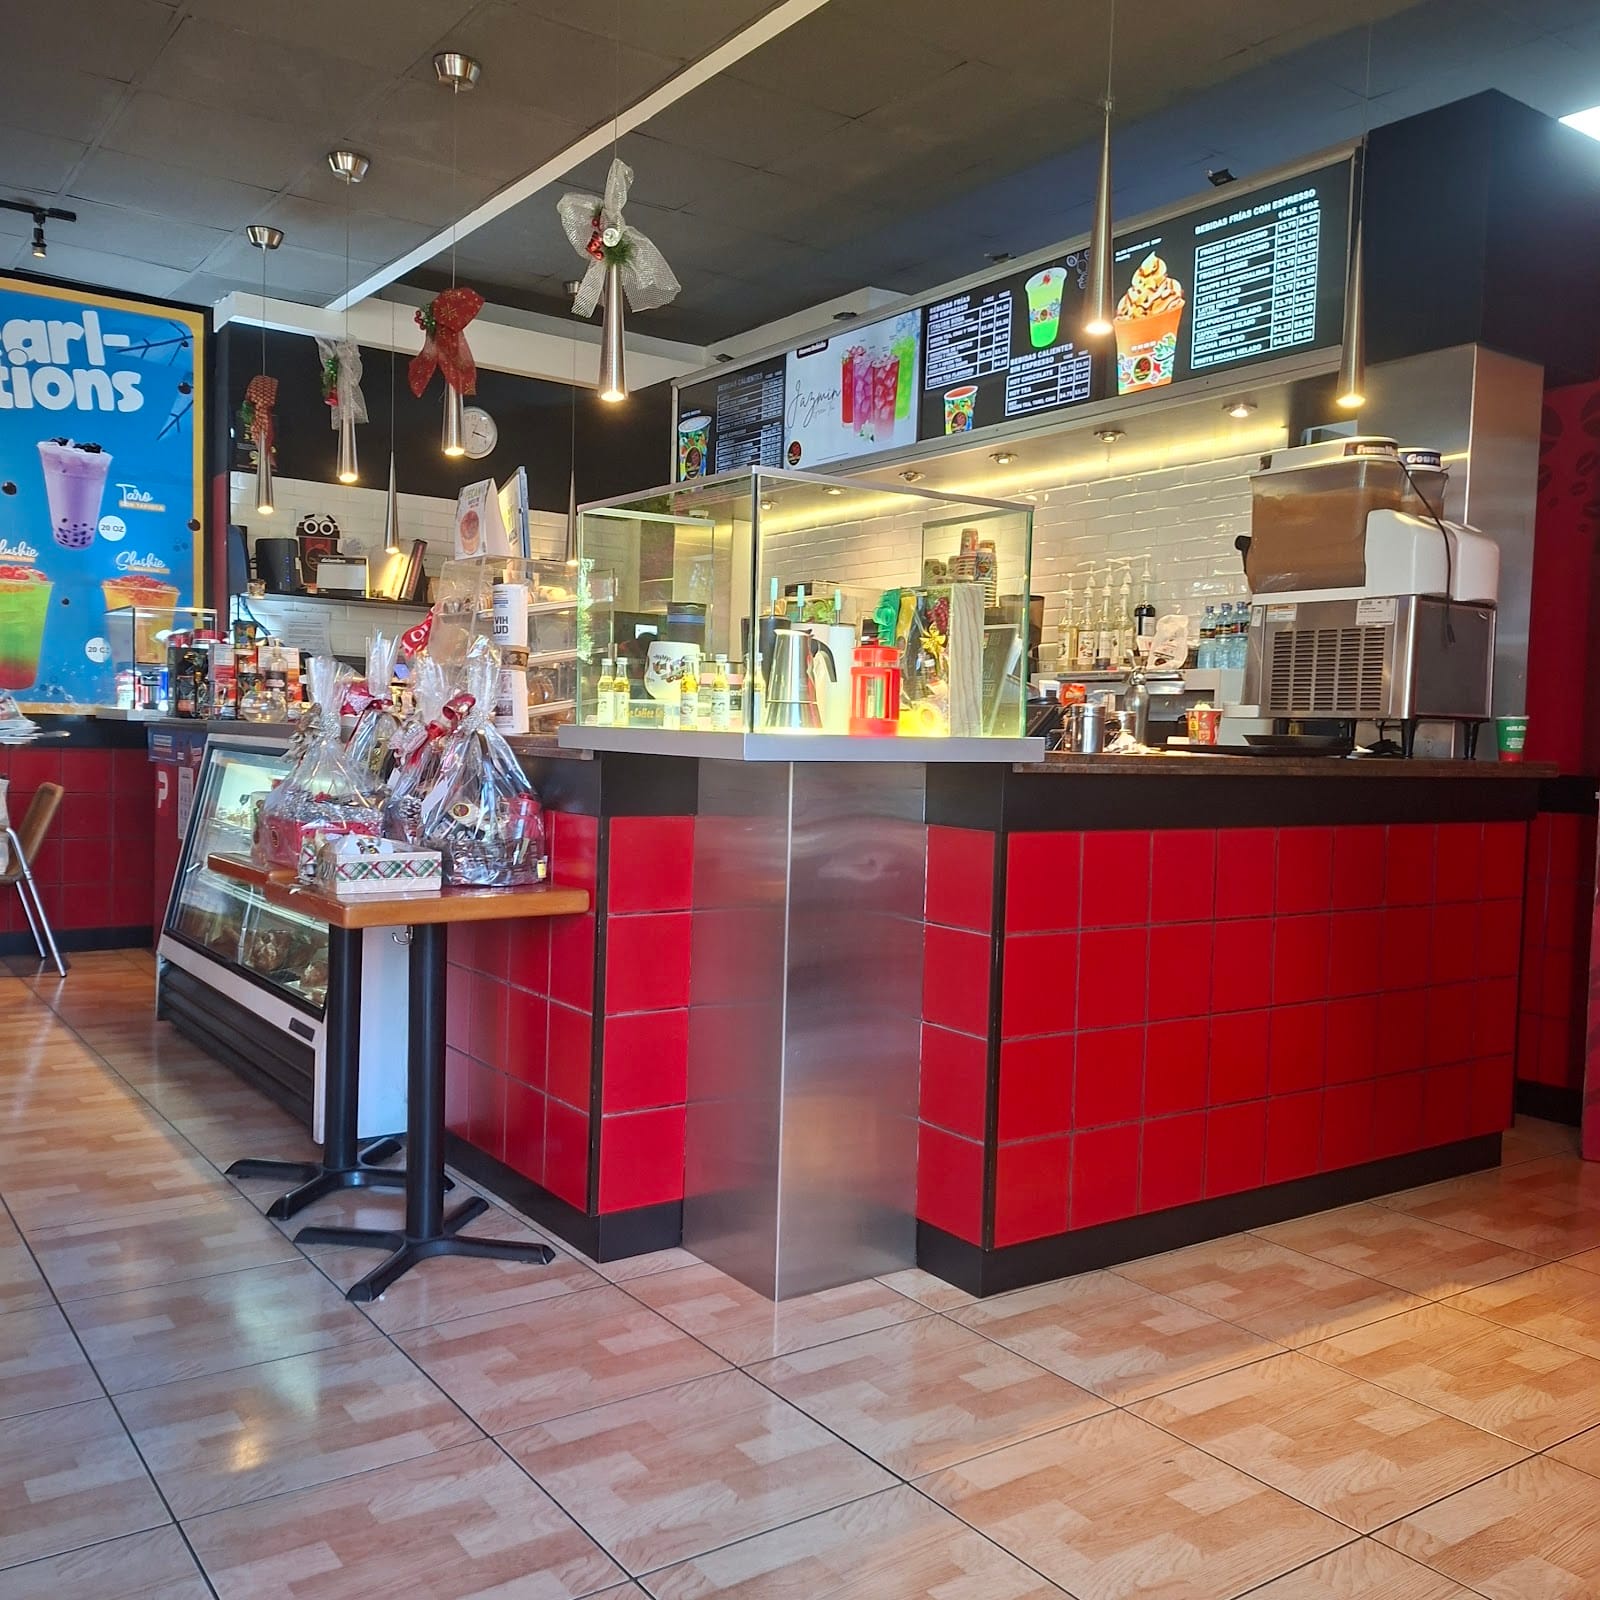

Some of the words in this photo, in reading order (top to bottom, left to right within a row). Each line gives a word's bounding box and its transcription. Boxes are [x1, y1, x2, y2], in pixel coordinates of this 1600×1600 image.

[1195, 217, 1228, 235] BEBIDAS
[1229, 209, 1252, 224] FRÍAS
[1253, 203, 1271, 216] CON
[1272, 188, 1316, 210] ESPRESSO
[1199, 244, 1226, 257] FROZEN
[1225, 230, 1268, 249] CAPPUCCINO
[1199, 255, 1226, 269] FROZEN
[1199, 267, 1225, 280] FROZEN
[929, 301, 953, 314] BEBIDAS
[953, 294, 970, 307] FRÍAS
[1197, 293, 1216, 305] LATTE
[1216, 286, 1241, 301] HELADO
[1215, 298, 1239, 310] HELADO
[939, 303, 968, 318] ESPRESSO
[1196, 314, 1235, 329] CAPPUCCINO
[1235, 305, 1262, 319] HELADO
[1231, 318, 1256, 331] HELADO
[0, 310, 130, 366] arl-
[1194, 340, 1218, 353] MOCHA
[1218, 334, 1245, 347] HELADO
[1010, 352, 1037, 366] BEBIDAS
[1037, 342, 1074, 359] CALIENTES
[1213, 348, 1236, 361] MOCHA
[1236, 343, 1262, 355] HELADO
[1021, 356, 1054, 371] ESPRESSO
[1009, 377, 1020, 386] HOT
[1021, 370, 1054, 383] CHOCOLATE
[1021, 386, 1032, 395] TEA
[115, 483, 153, 504] Taro
[112, 525, 125, 533] OZ
[0, 538, 40, 558] lushie
[115, 550, 166, 571] Slushie
